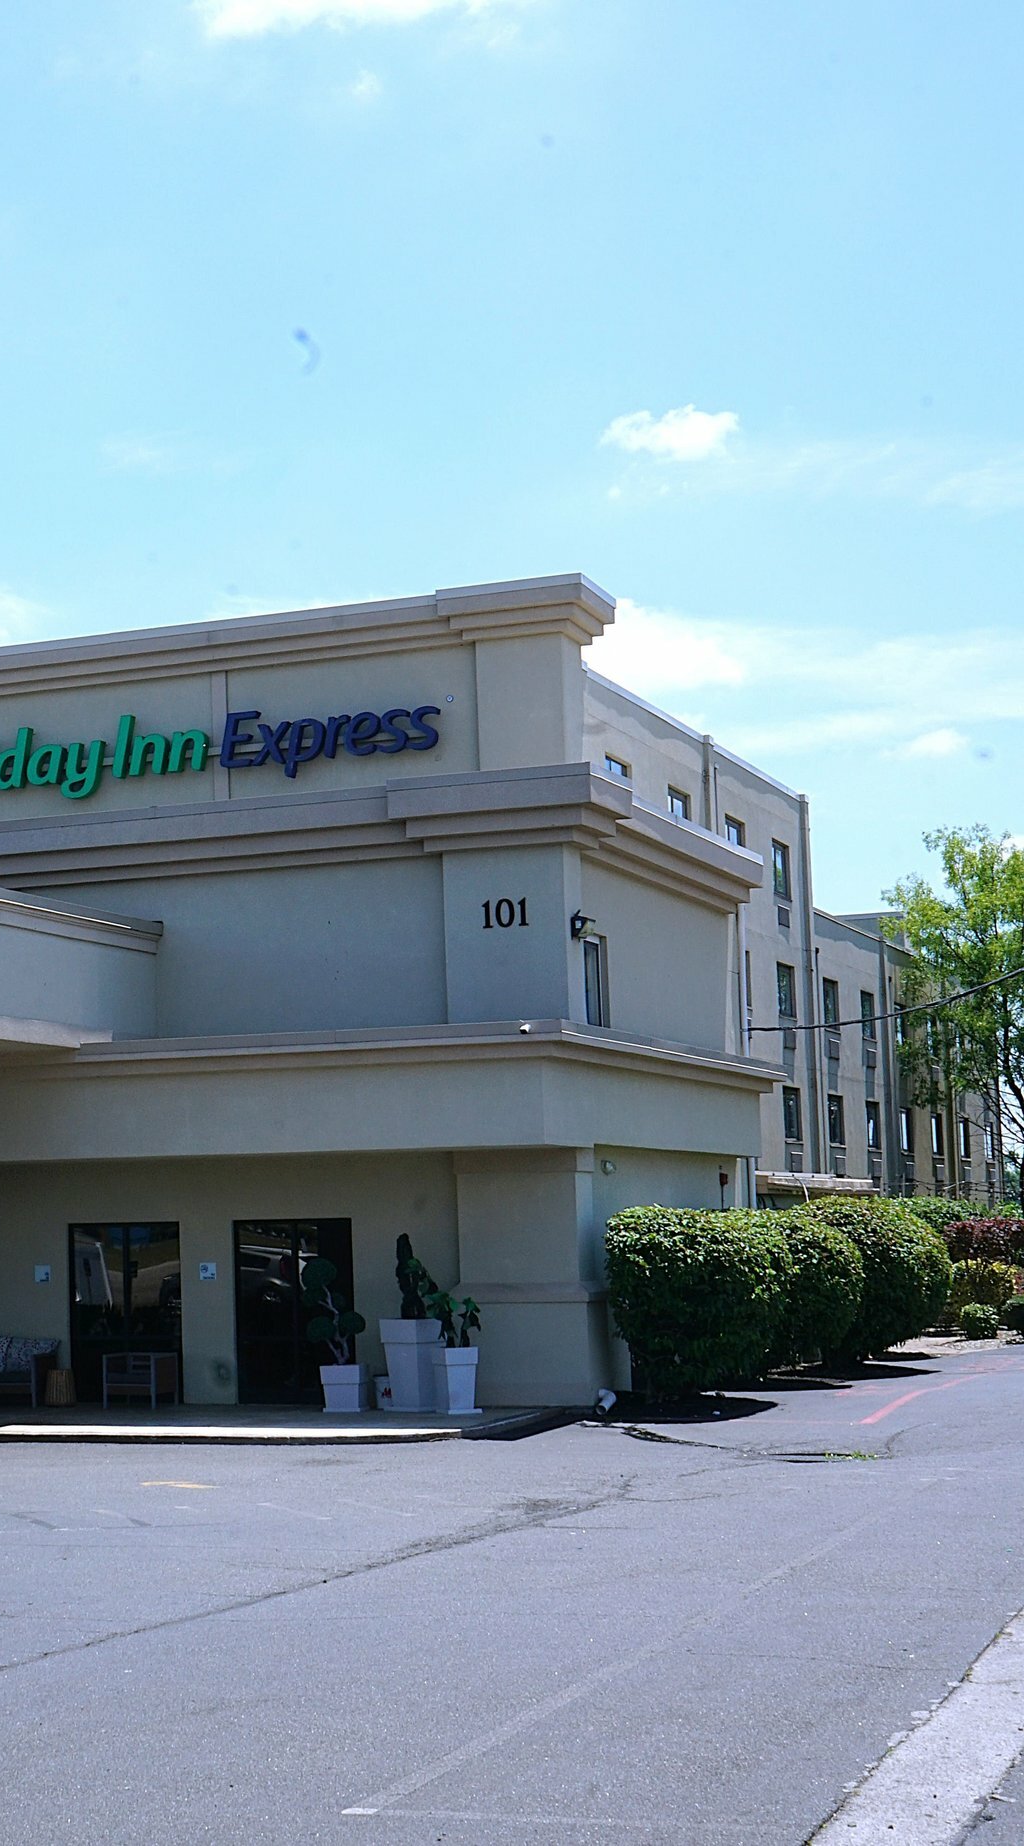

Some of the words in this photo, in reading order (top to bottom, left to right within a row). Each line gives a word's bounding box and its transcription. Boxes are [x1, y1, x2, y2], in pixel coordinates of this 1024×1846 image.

[112, 714, 210, 779] Inn
[220, 705, 441, 779] Express
[481, 896, 529, 929] 101
